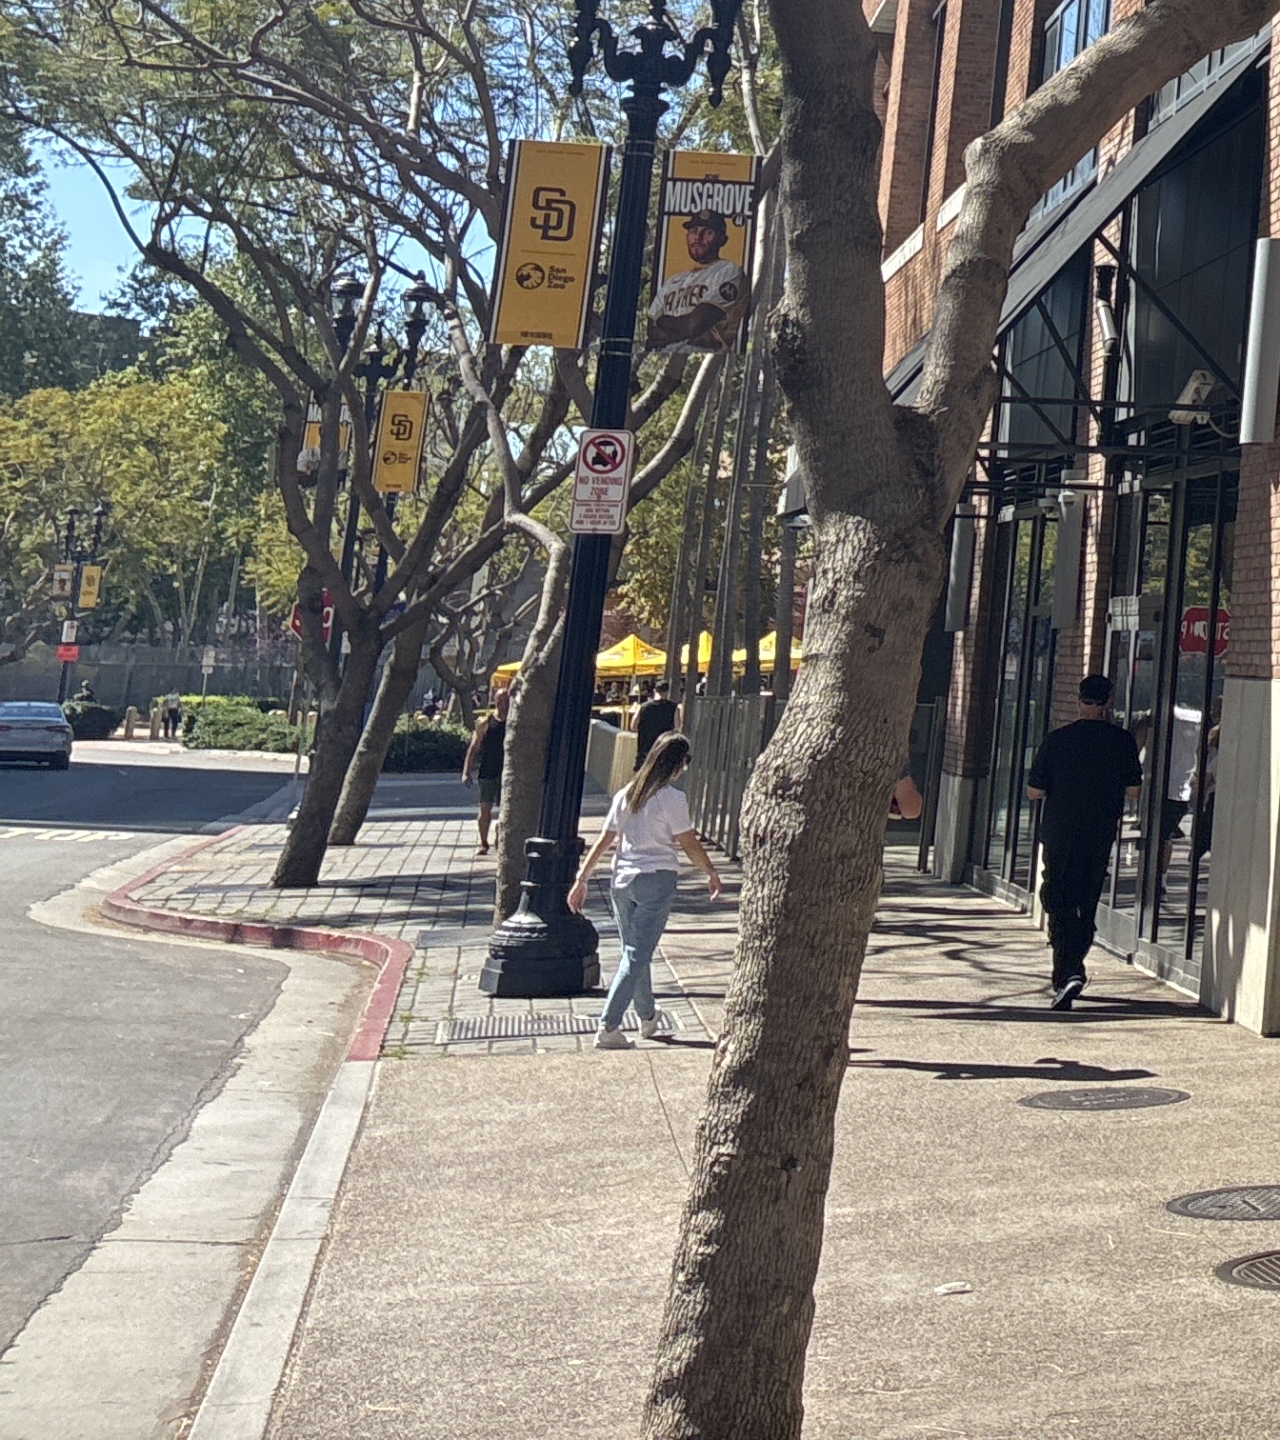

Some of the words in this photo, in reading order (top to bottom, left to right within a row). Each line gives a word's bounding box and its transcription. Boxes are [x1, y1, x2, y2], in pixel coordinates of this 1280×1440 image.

[664, 180, 755, 216] MUSGROVE
[530, 186, 576, 242] SD
[548, 265, 567, 274] San
[548, 273, 575, 283] Diego
[547, 281, 566, 289] Zoo
[578, 476, 589, 485] NO
[590, 487, 609, 496] ZONE
